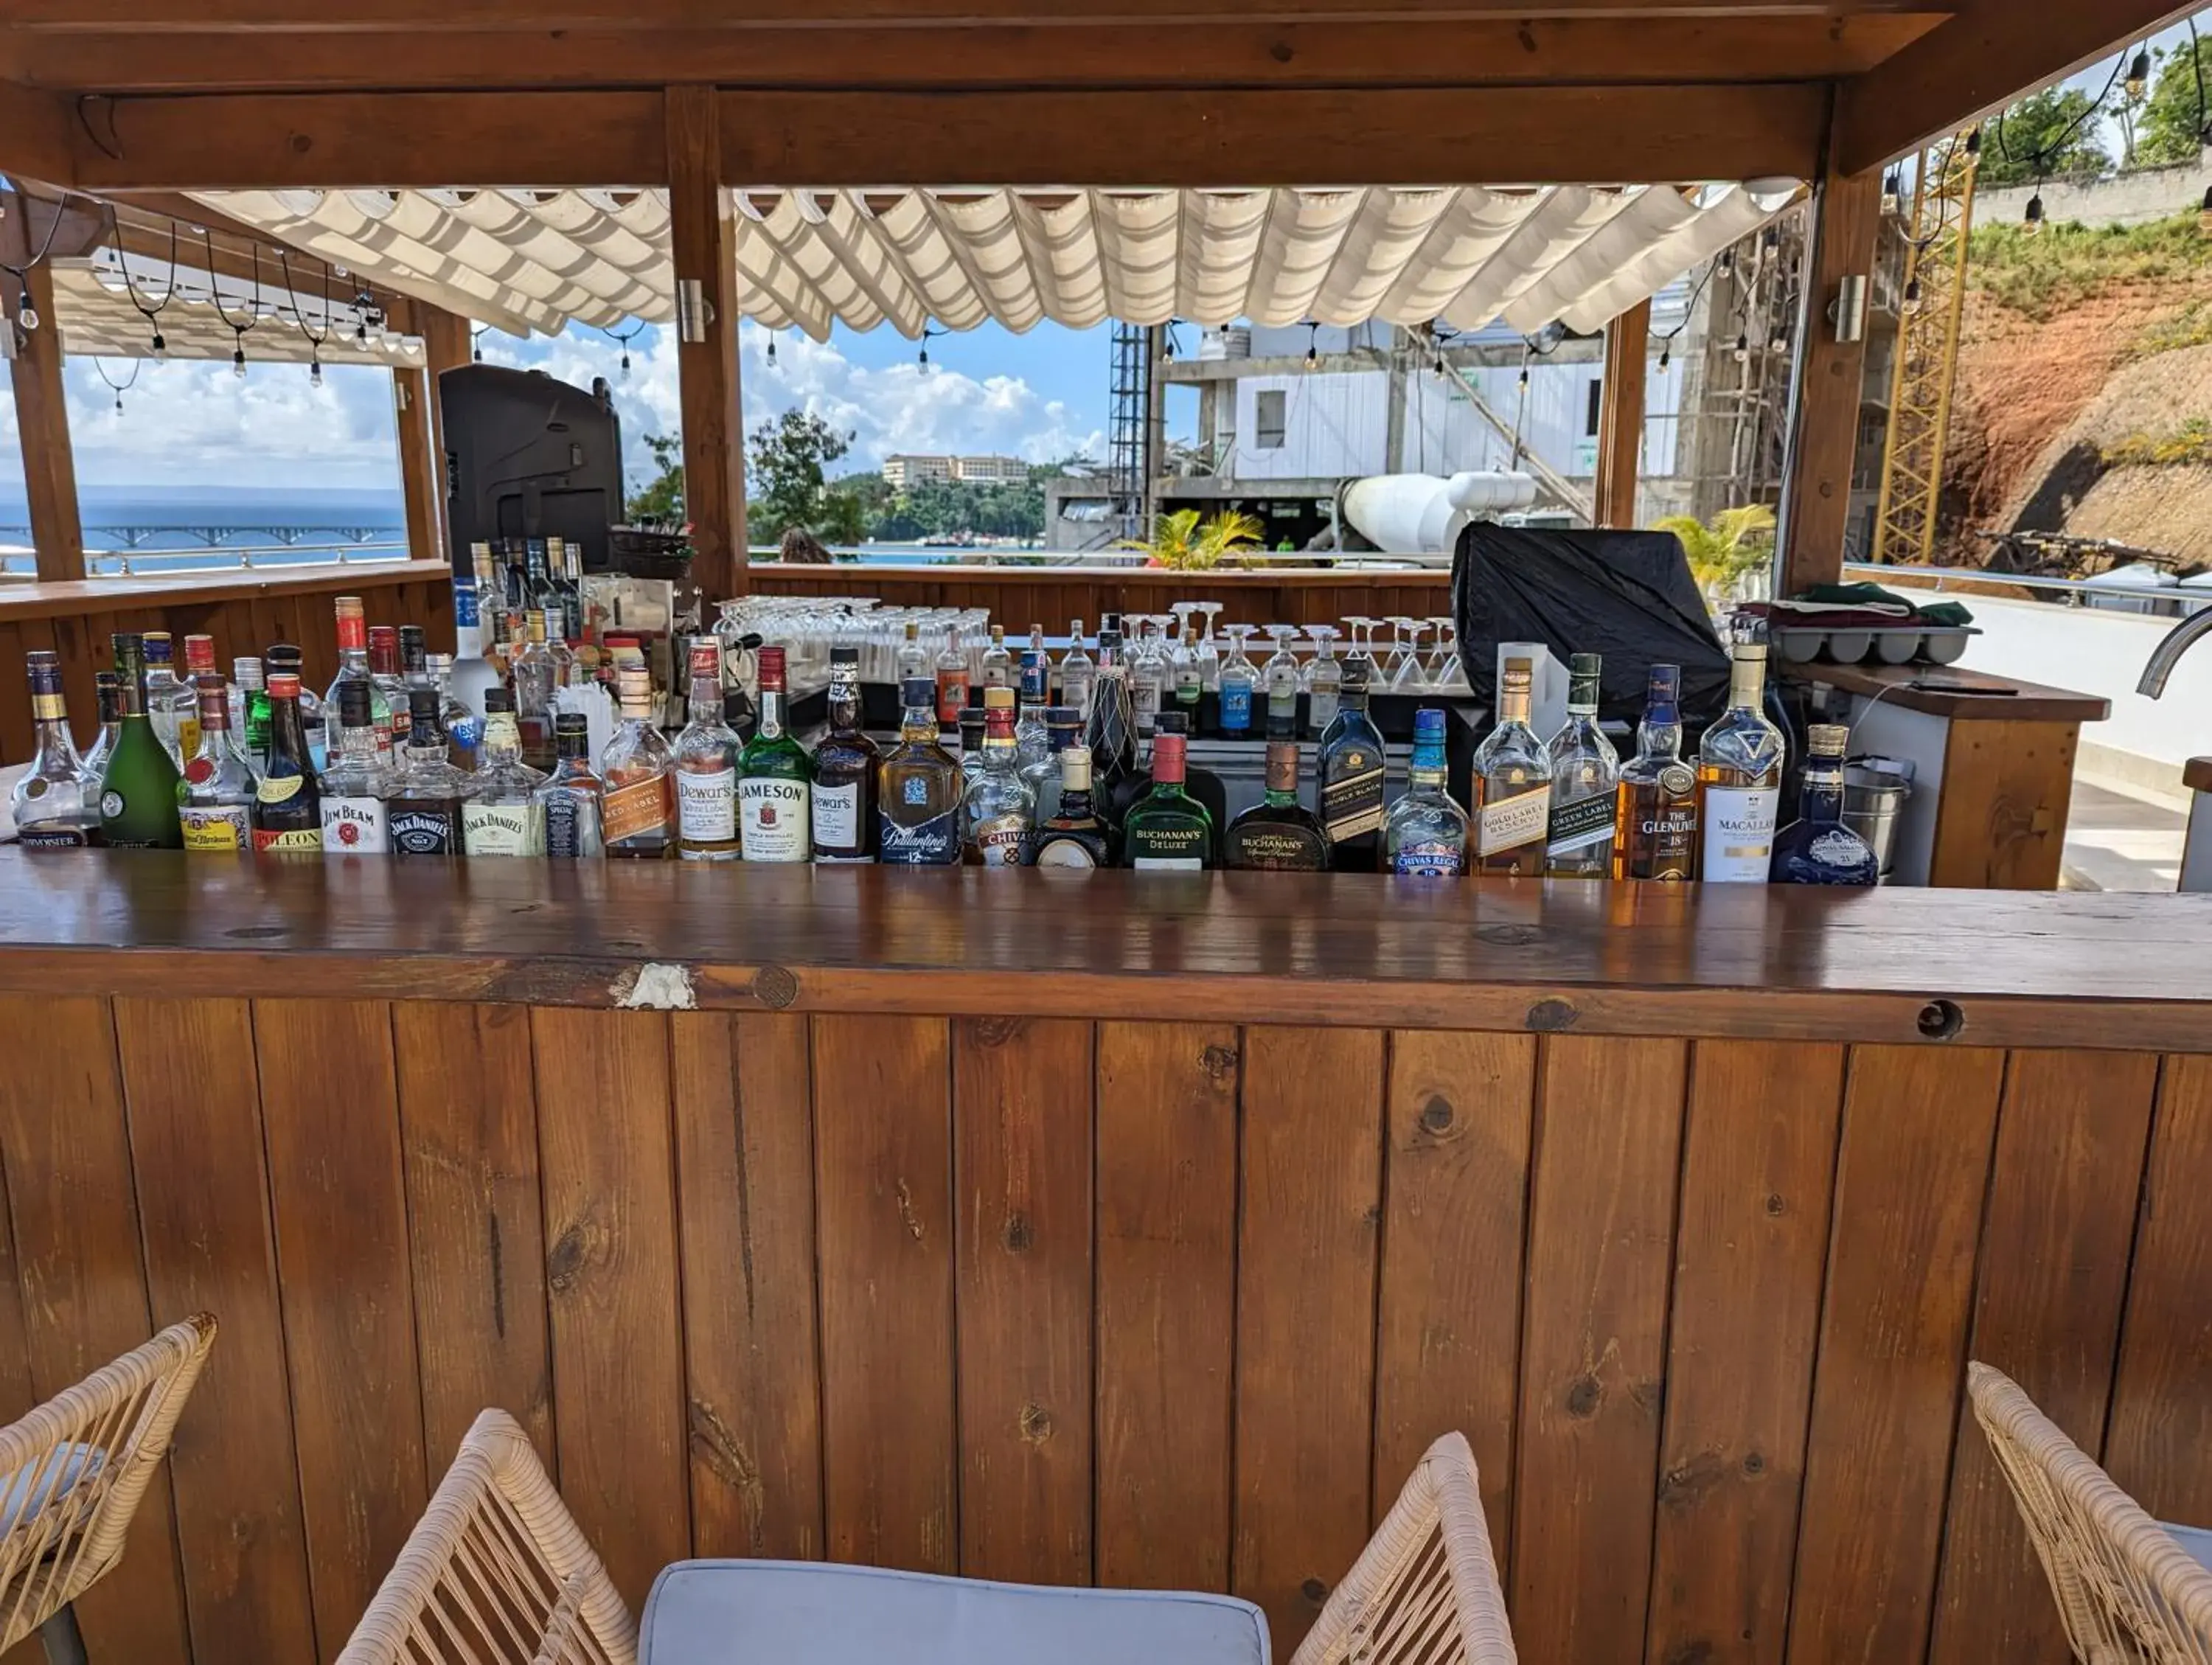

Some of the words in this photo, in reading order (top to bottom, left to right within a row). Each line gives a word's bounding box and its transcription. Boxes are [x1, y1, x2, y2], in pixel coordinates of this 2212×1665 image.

[680, 783, 731, 799] Dewar's
[740, 785, 803, 801] JAMESON
[324, 809, 340, 827] JIM
[341, 804, 374, 826] BEAM
[1552, 813, 1582, 827] GREEN
[1586, 802, 1613, 817] LABEL
[1669, 812, 1687, 821] THE
[391, 820, 412, 835] JACK
[412, 815, 448, 837] DANIEL'S
[465, 816, 488, 833] JACK
[487, 813, 524, 834] DANIEL'S
[881, 827, 948, 849] Ballantine's
[1136, 830, 1203, 839] BUCHANAN'S
[1241, 838, 1304, 849] BUCHANAN'S
[908, 851, 922, 863] 12
[1398, 857, 1432, 866] CHIVAS
[1433, 856, 1460, 866] REGAL
